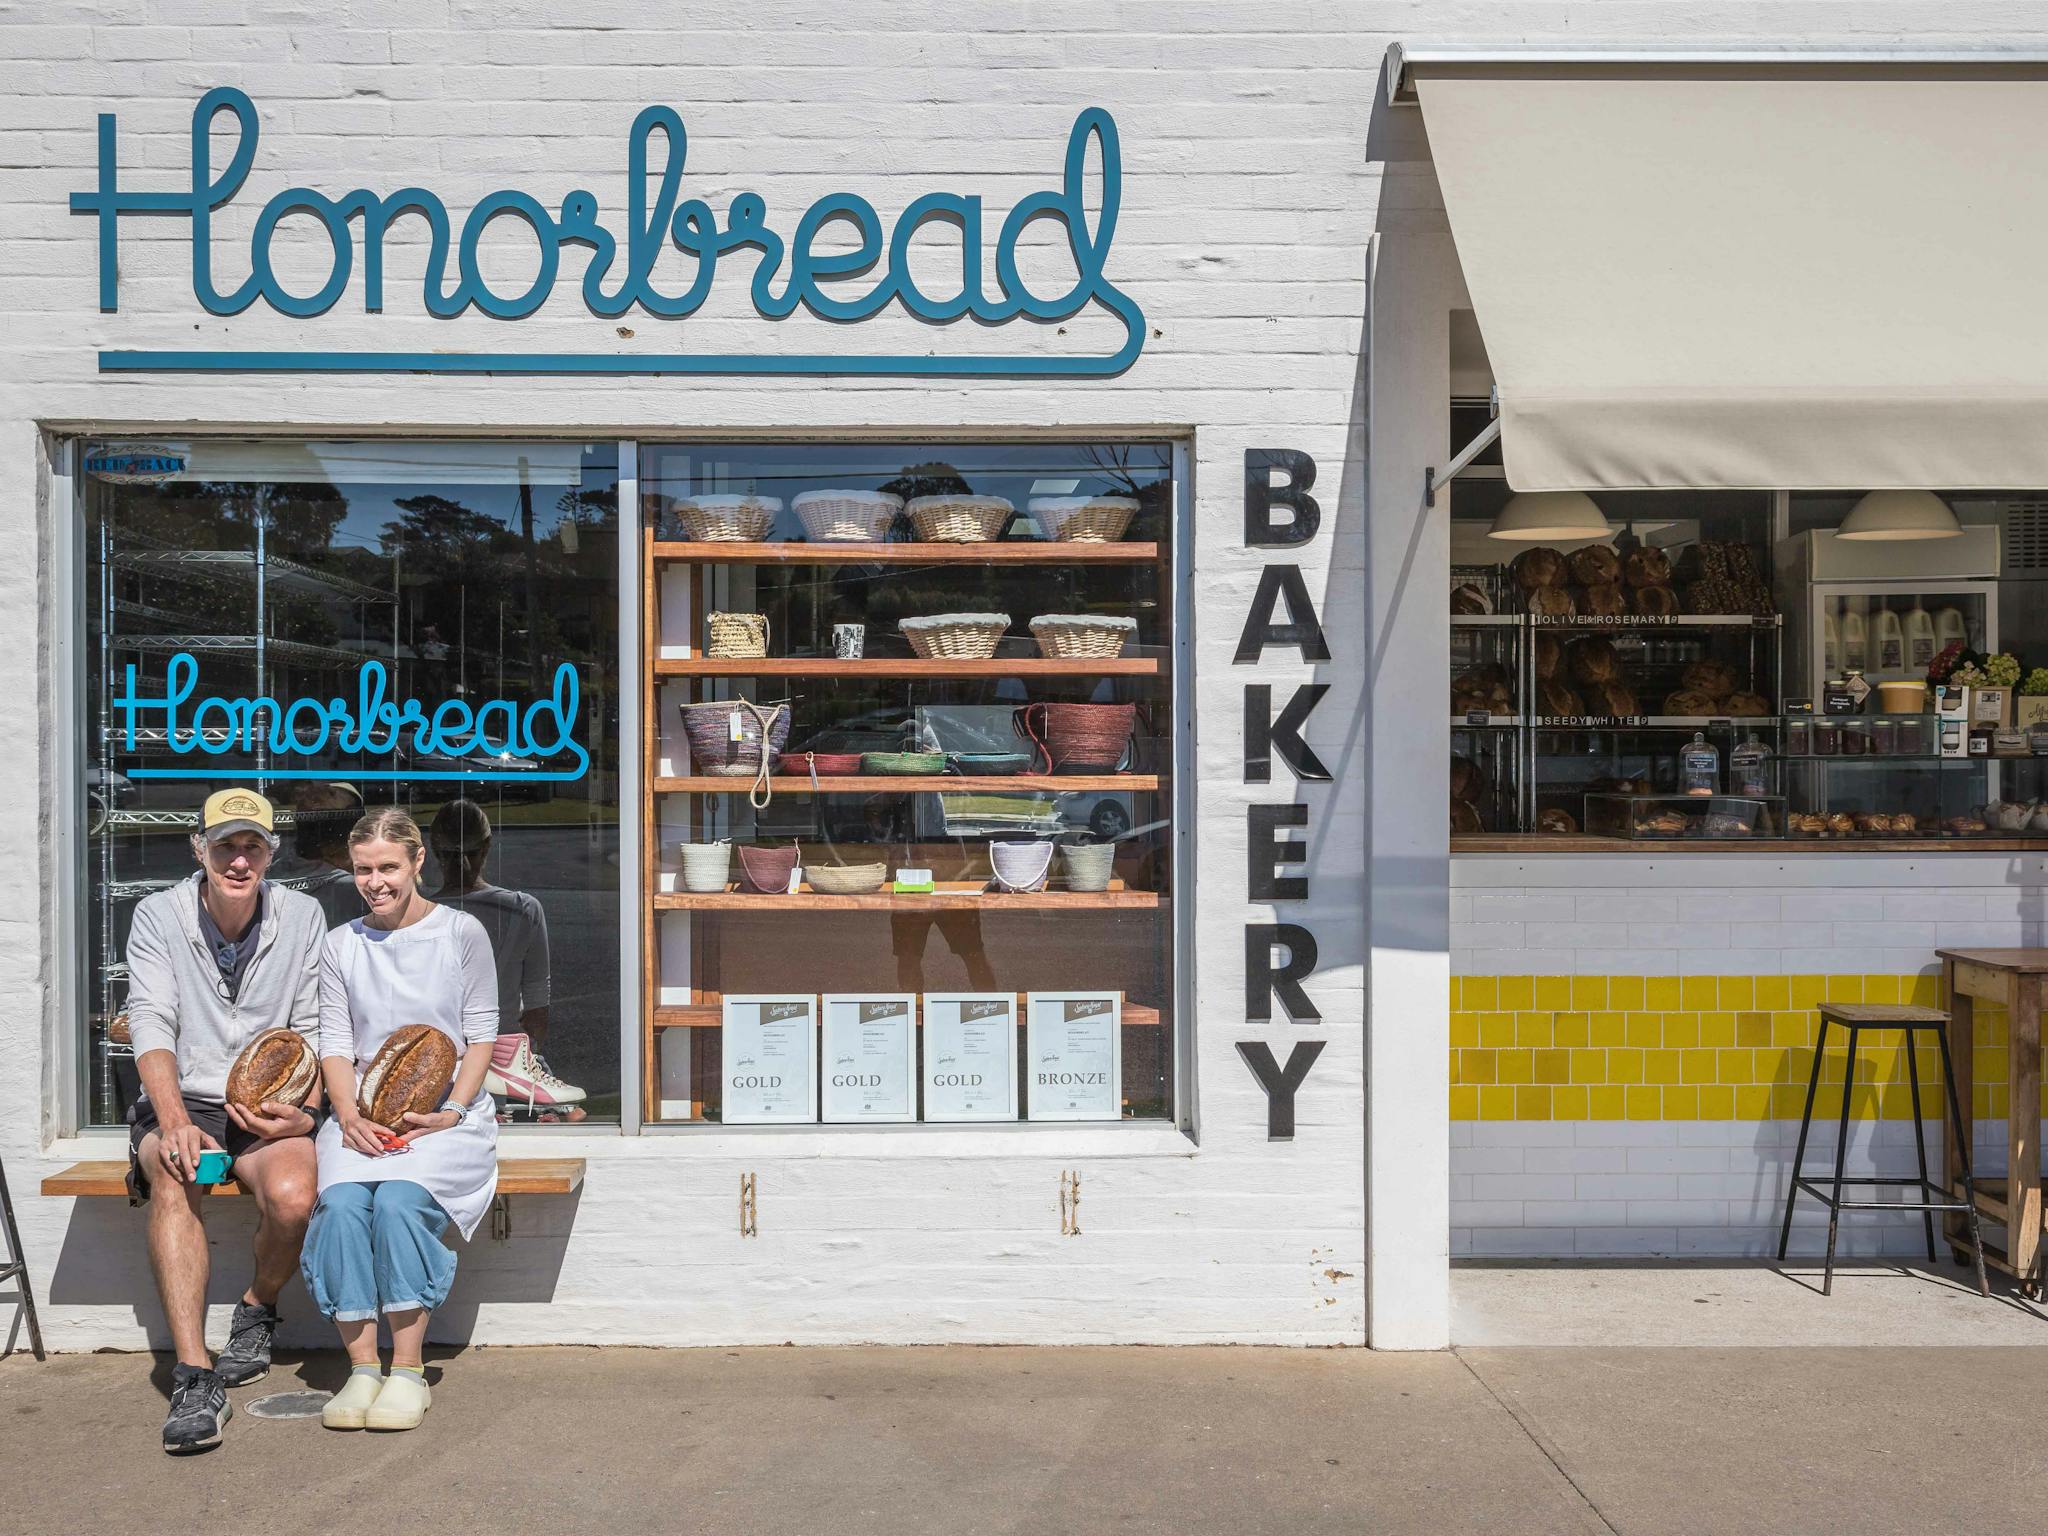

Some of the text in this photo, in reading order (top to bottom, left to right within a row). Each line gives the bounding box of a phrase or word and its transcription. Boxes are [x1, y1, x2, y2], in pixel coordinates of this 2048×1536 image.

[70, 86, 1146, 374] Honorbread
[1542, 615, 1585, 624] OLIVE
[1596, 615, 1665, 624] ROSEMARY
[113, 653, 589, 781] Honorbread
[1544, 716, 1586, 725] SEEDY
[1591, 716, 1634, 725] WHITE
[1232, 448, 1333, 1142] BAKERY
[732, 1076, 782, 1088] GOLD
[832, 1075, 881, 1087] GOLD
[933, 1074, 982, 1086] GOLD
[1038, 1073, 1106, 1085] BRONZE
